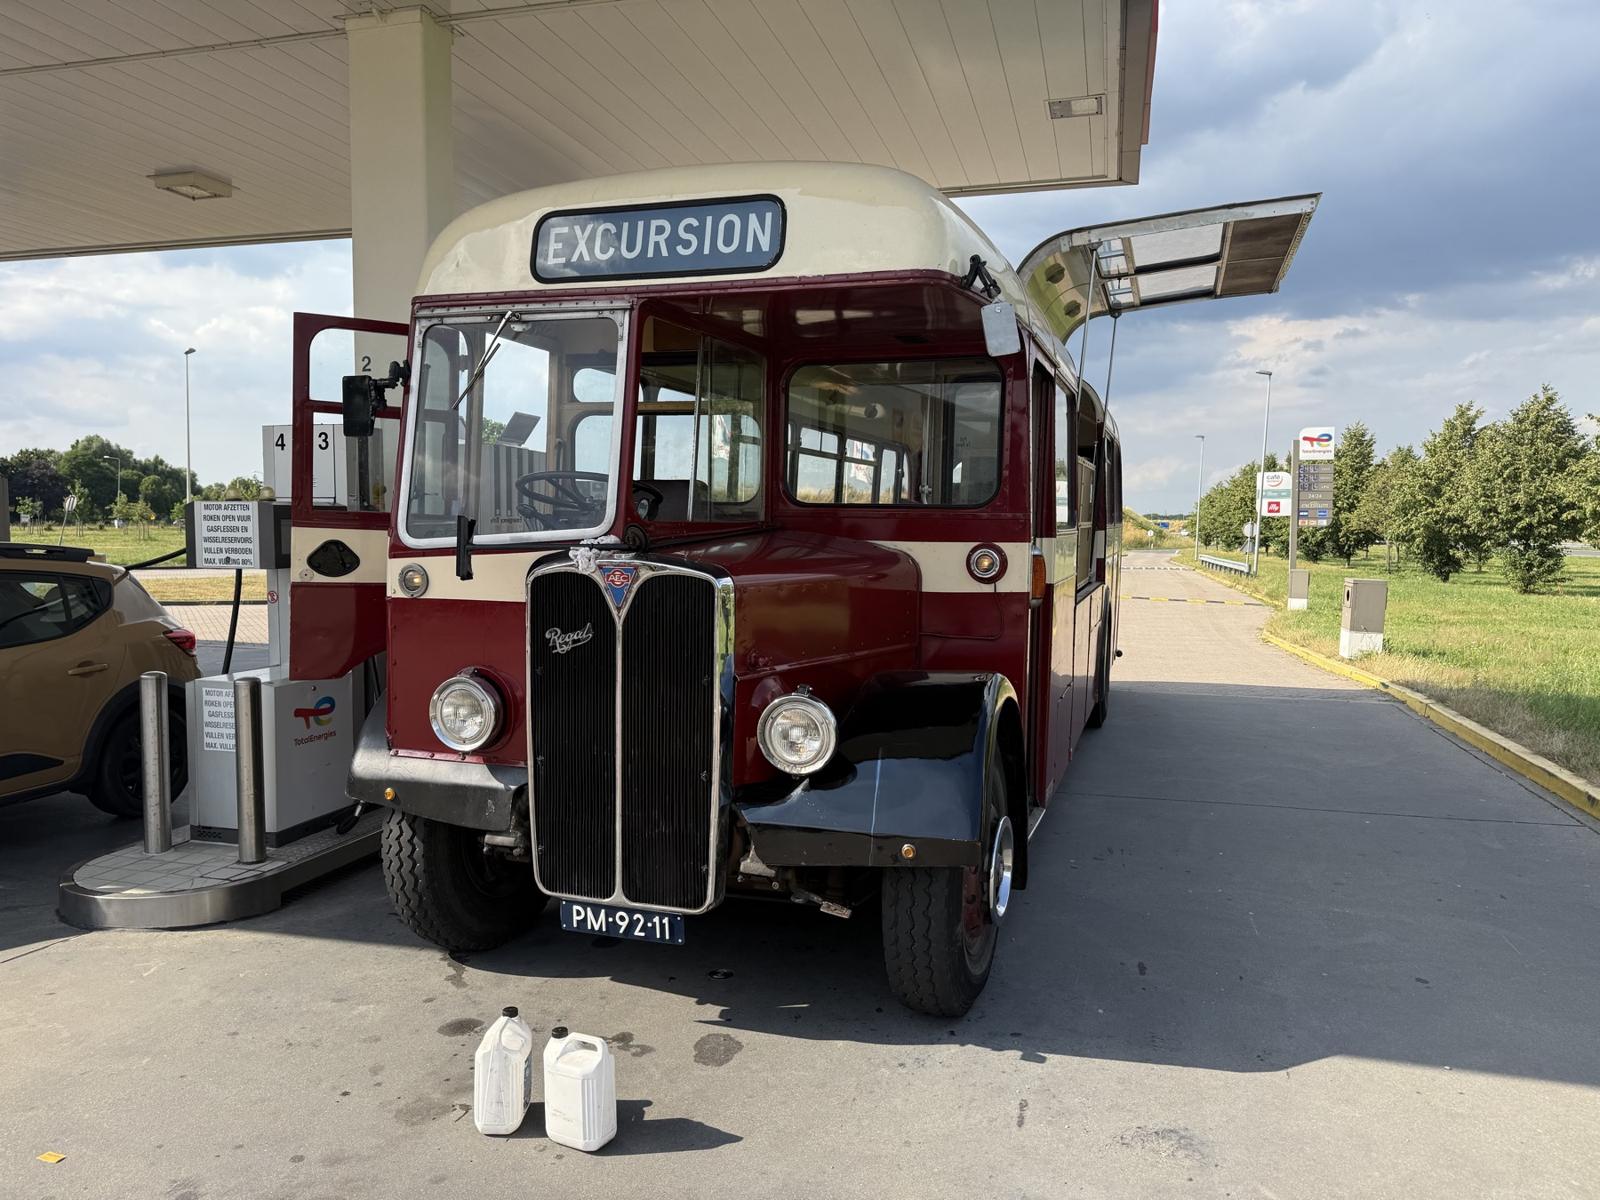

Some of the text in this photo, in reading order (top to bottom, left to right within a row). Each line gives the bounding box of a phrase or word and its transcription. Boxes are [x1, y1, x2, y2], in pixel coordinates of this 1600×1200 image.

[547, 212, 773, 265] EXCURSION
[361, 356, 372, 372] 2
[275, 433, 286, 451] 4
[318, 432, 329, 450] 3
[545, 622, 594, 654] Regal
[294, 730, 336, 746] TotalEnergies
